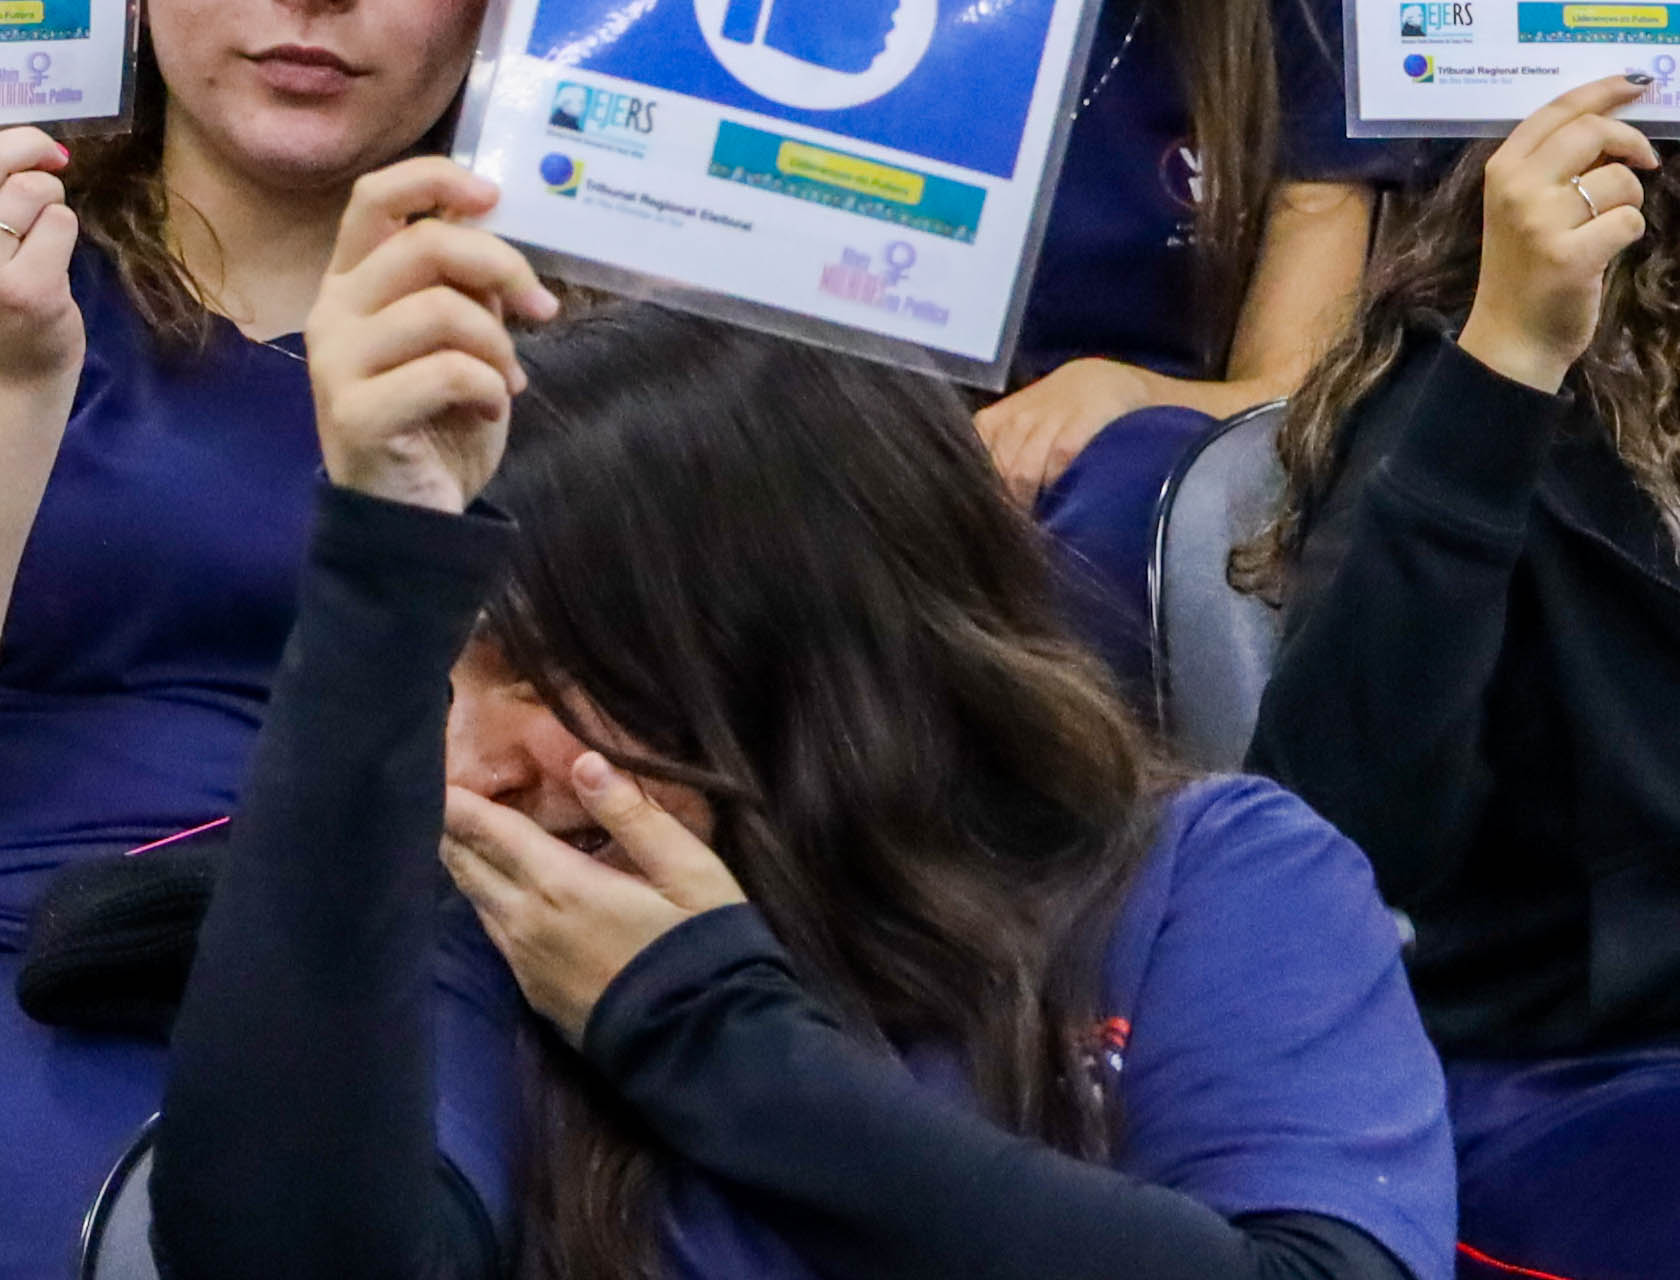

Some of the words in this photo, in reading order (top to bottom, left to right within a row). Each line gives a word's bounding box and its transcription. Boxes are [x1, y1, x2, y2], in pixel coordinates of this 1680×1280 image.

[1428, 2, 1472, 29] EJERS
[1438, 66, 1474, 75] Tribunal
[1477, 66, 1518, 76] Regional
[1521, 66, 1559, 74] Eleitoral
[590, 89, 657, 140] EJERS
[584, 179, 637, 203] Tribunal
[639, 193, 697, 220] Regional
